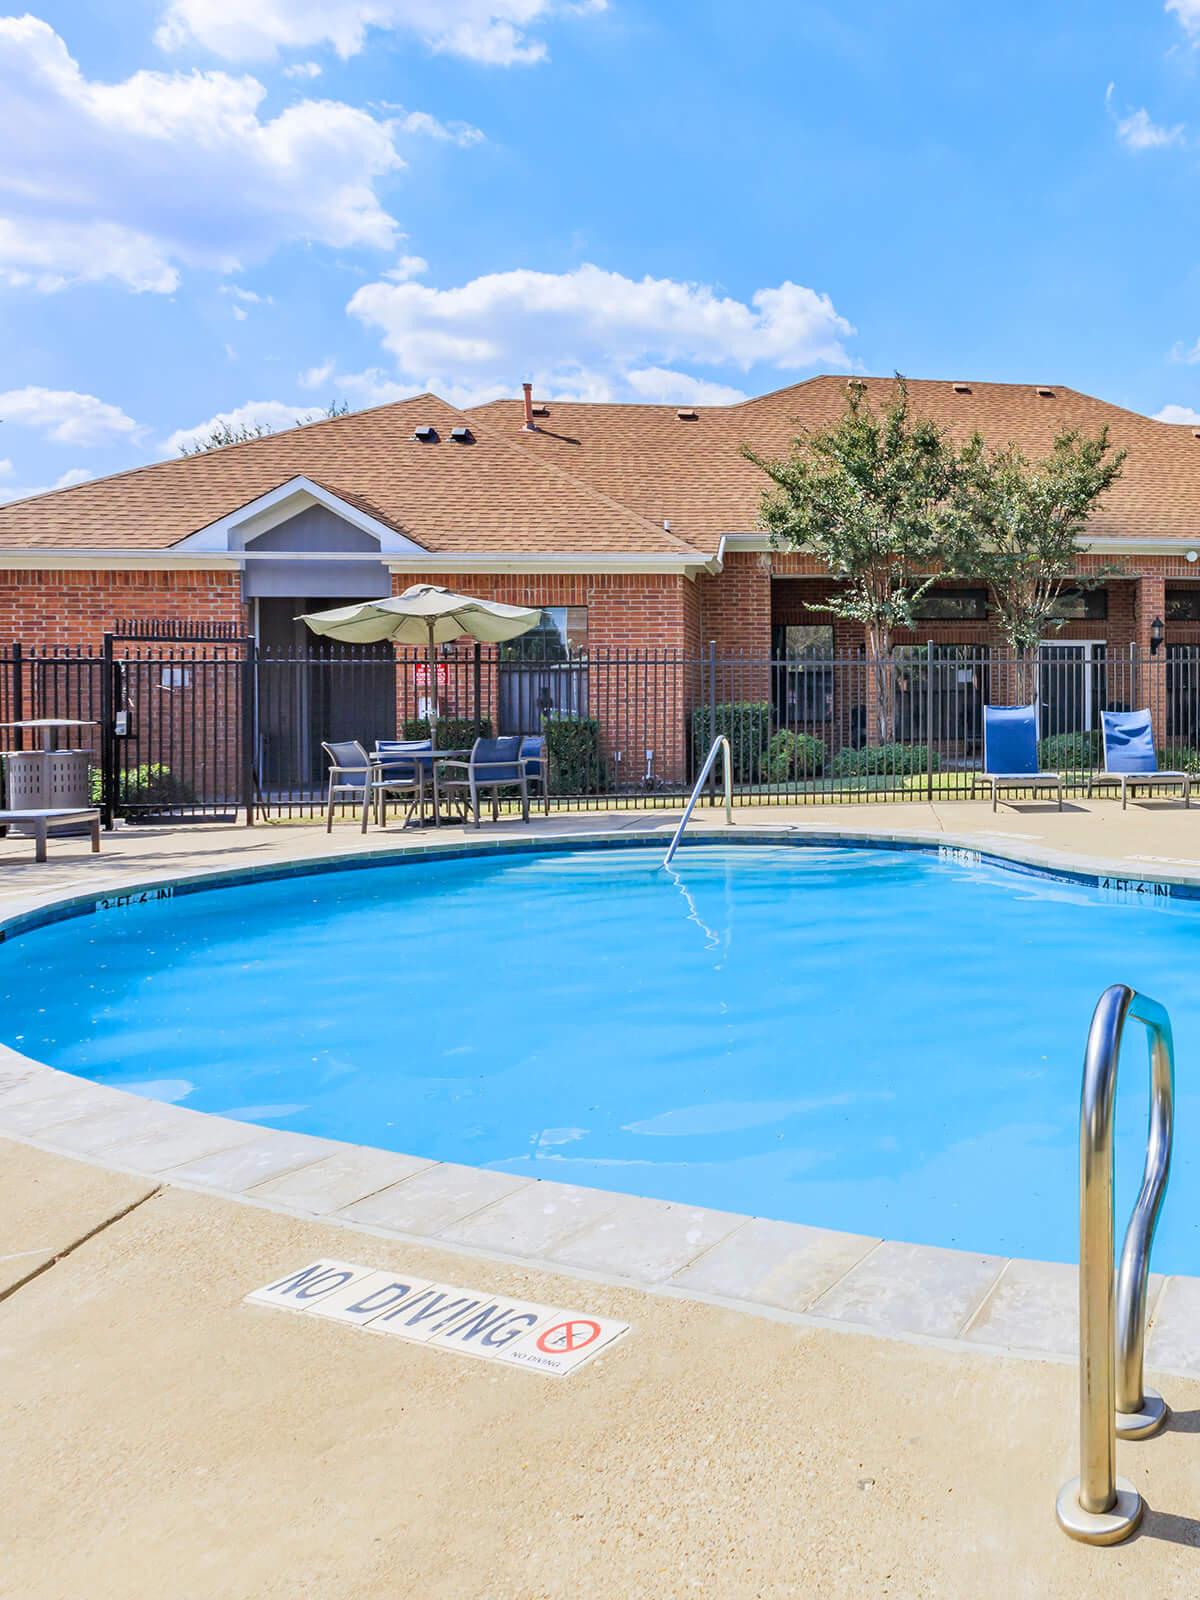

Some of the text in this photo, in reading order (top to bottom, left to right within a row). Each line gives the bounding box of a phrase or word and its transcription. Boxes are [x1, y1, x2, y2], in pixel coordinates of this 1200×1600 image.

[1116, 879, 1129, 892] FT
[1154, 884, 1167, 896] IN
[117, 895, 131, 907] FT
[157, 887, 171, 900] IN
[267, 1264, 538, 1348] NO DIVING
[510, 1351, 561, 1368] NO DIVING
